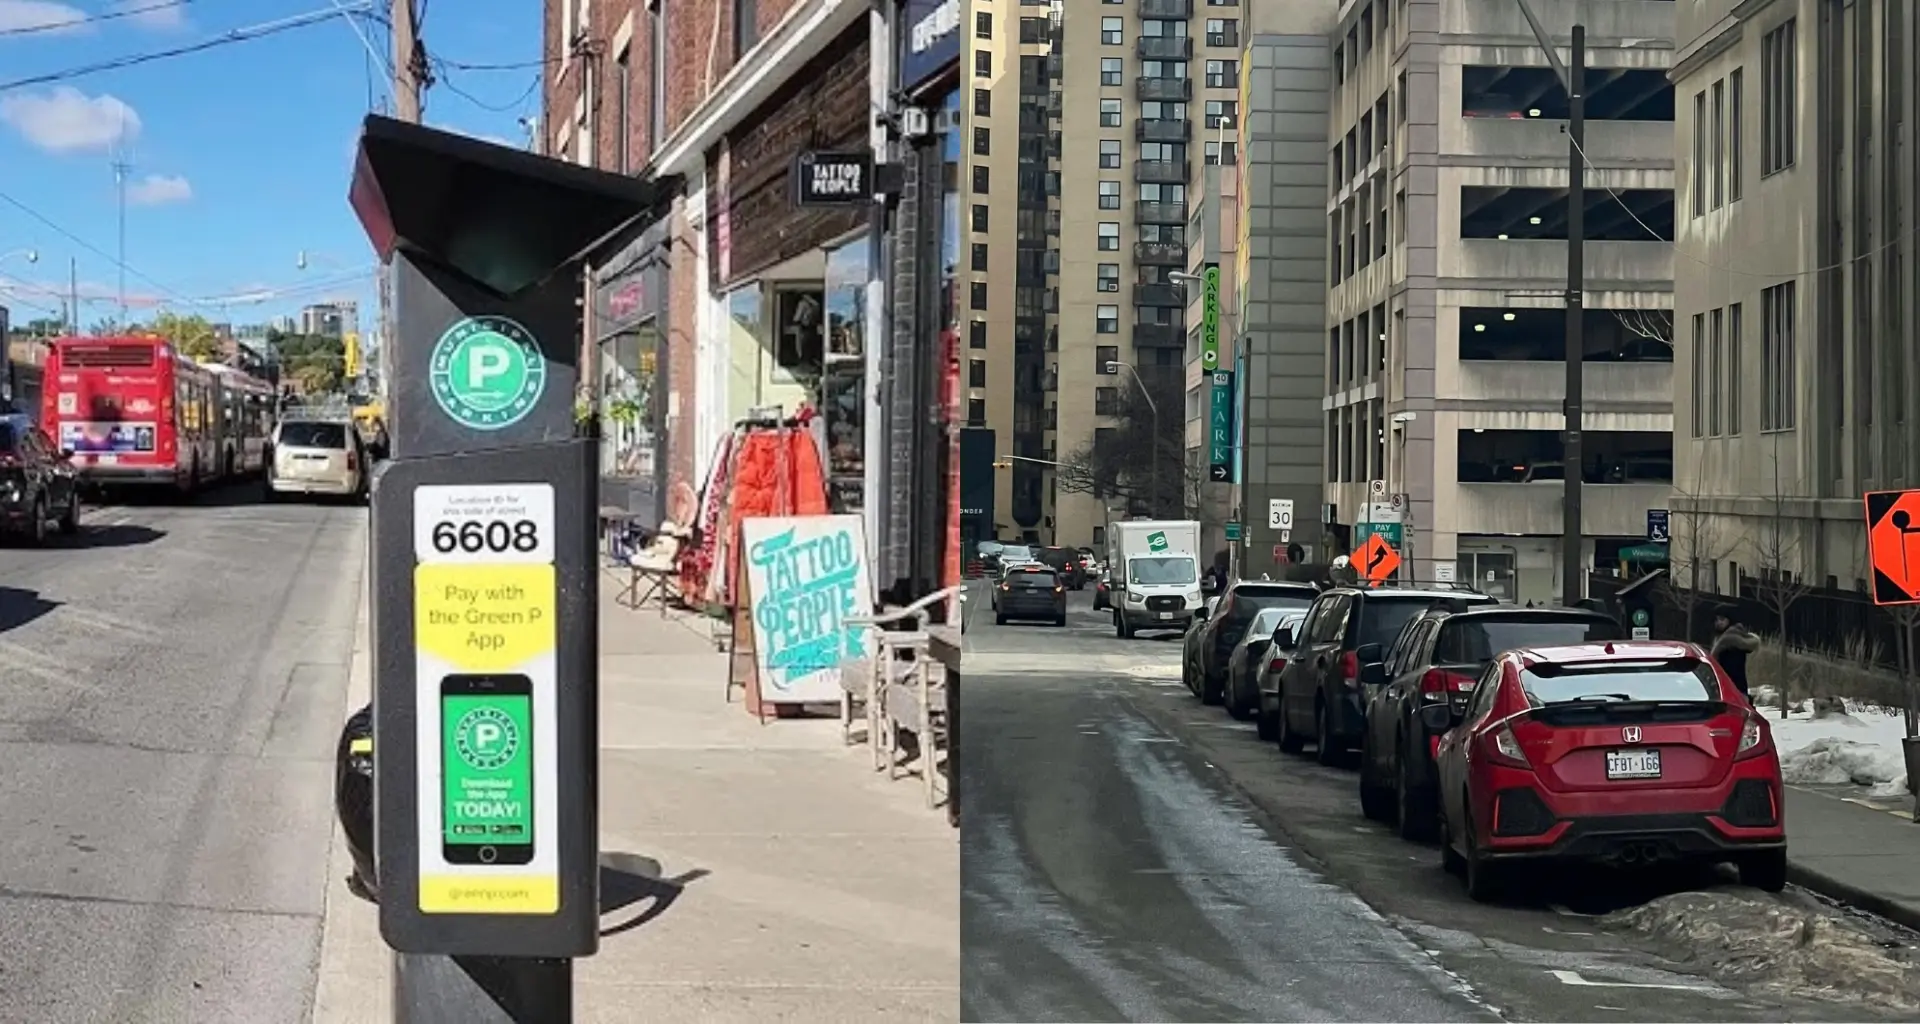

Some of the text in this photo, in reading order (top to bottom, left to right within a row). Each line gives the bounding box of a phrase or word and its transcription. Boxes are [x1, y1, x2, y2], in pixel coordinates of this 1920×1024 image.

[814, 164, 860, 179] TATTOO
[812, 180, 860, 194] PEOPLE
[1206, 272, 1217, 344] PARKING
[437, 321, 538, 368] MUNICIPAL
[468, 345, 511, 389] P
[1215, 373, 1227, 383] 40
[437, 380, 537, 423] PARKING
[1214, 391, 1226, 461] PARK
[1272, 511, 1290, 525] 30
[1375, 523, 1391, 532] PAY
[432, 520, 539, 553] 6608
[752, 530, 853, 602] TATTOO
[444, 583, 525, 606] Pay with
[429, 606, 542, 625] the Green P
[466, 631, 506, 651] App
[476, 723, 500, 749] P
[453, 801, 522, 818] TODAY!
